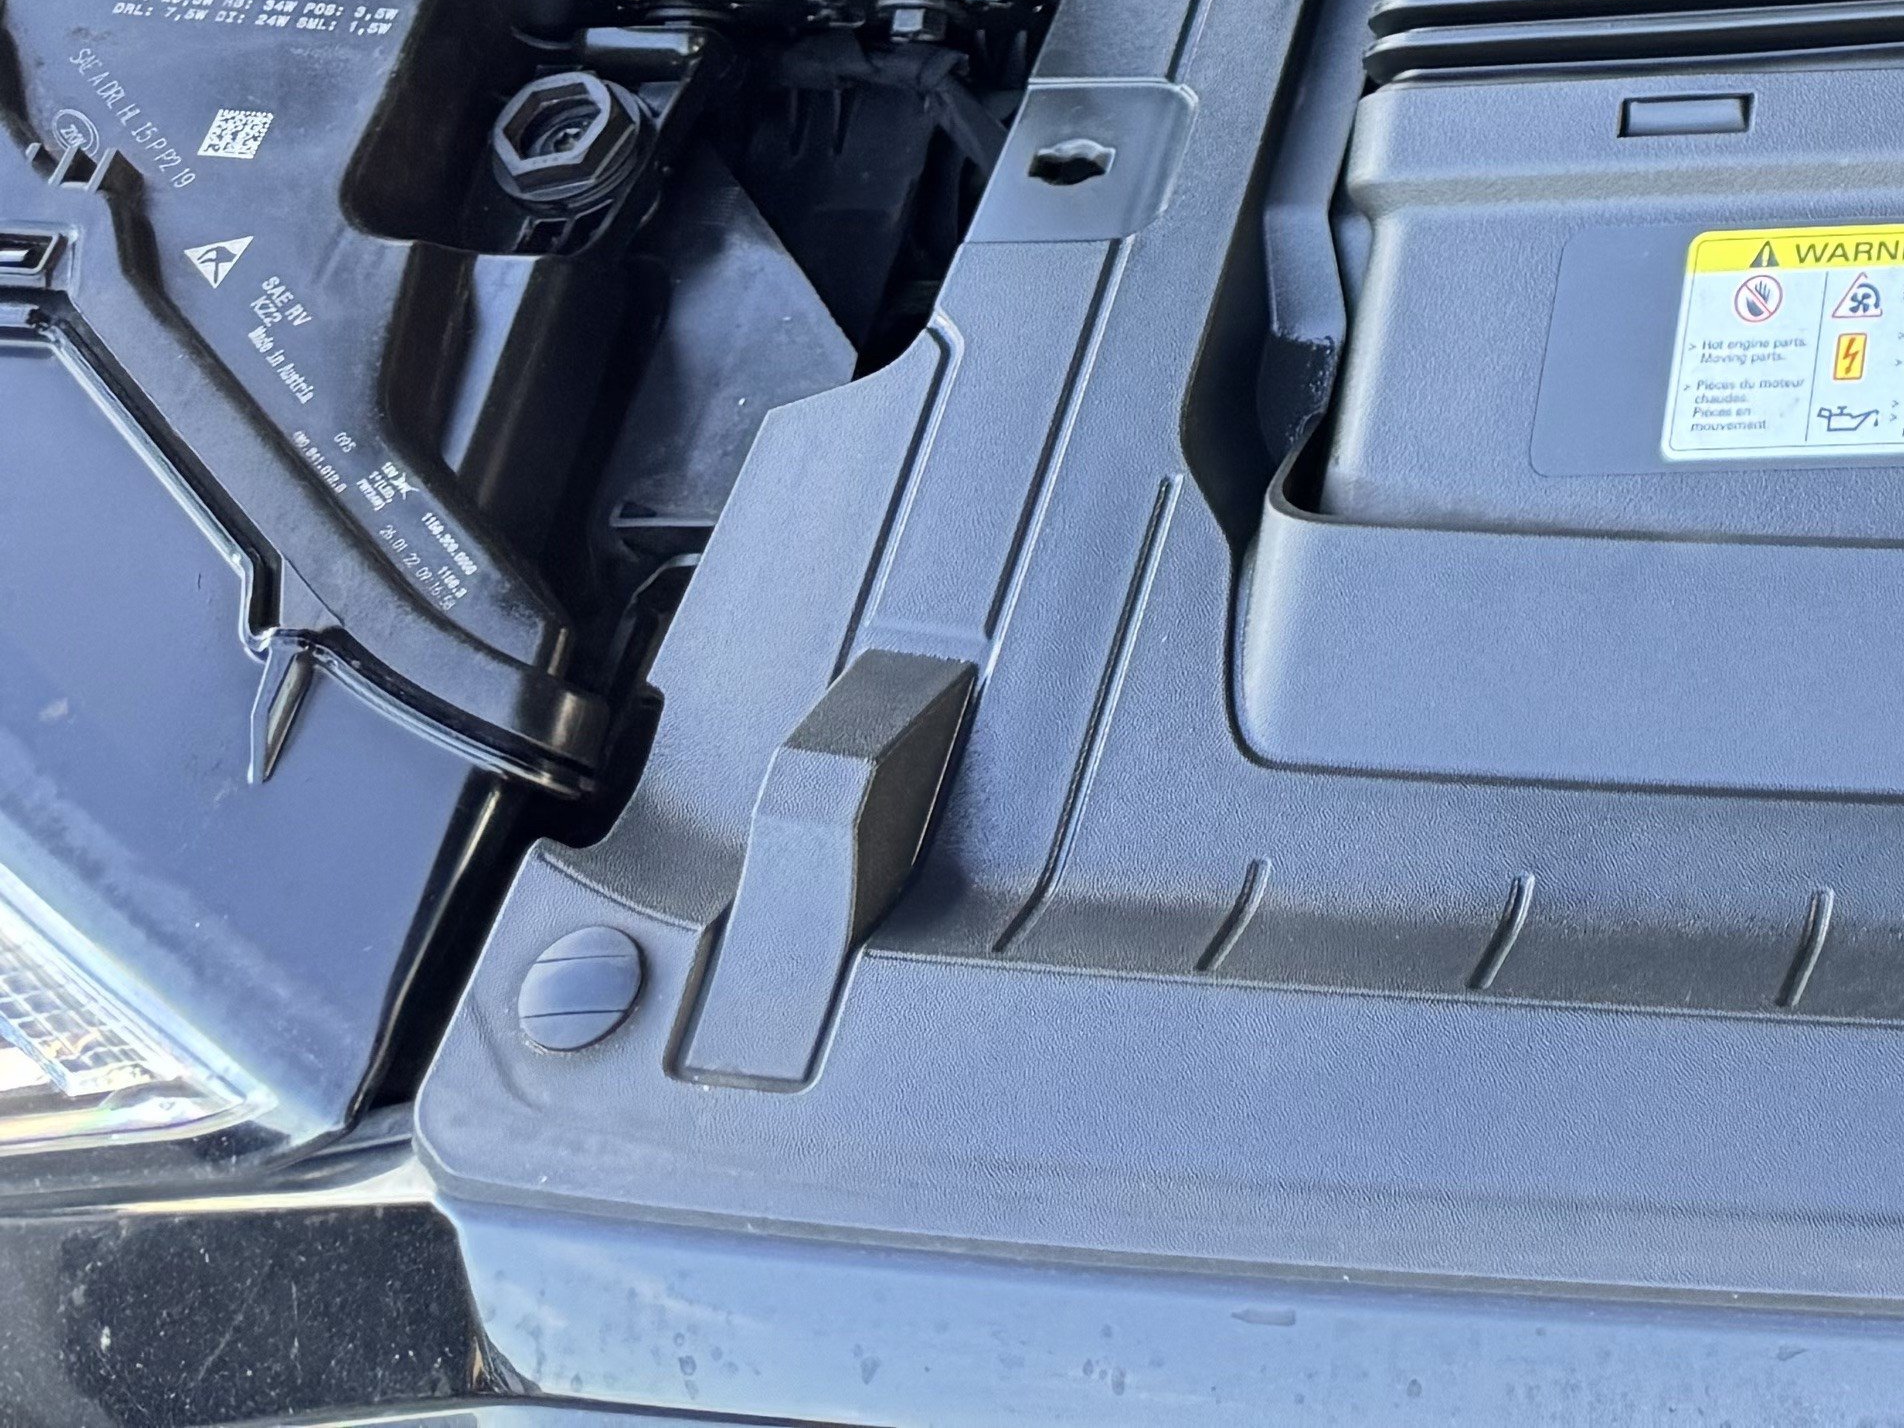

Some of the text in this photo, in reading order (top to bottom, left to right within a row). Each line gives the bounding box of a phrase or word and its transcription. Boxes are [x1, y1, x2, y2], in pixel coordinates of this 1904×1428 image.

[263, 0, 298, 13] 34W
[254, 13, 291, 28] 24W
[88, 71, 110, 87] A
[262, 276, 294, 307] SAE
[1702, 339, 1724, 350] Hot
[1727, 339, 1770, 351] engine
[1700, 352, 1748, 365] Moving
[265, 349, 285, 368] in
[277, 363, 314, 405] Austria
[1759, 378, 1805, 389] moteur
